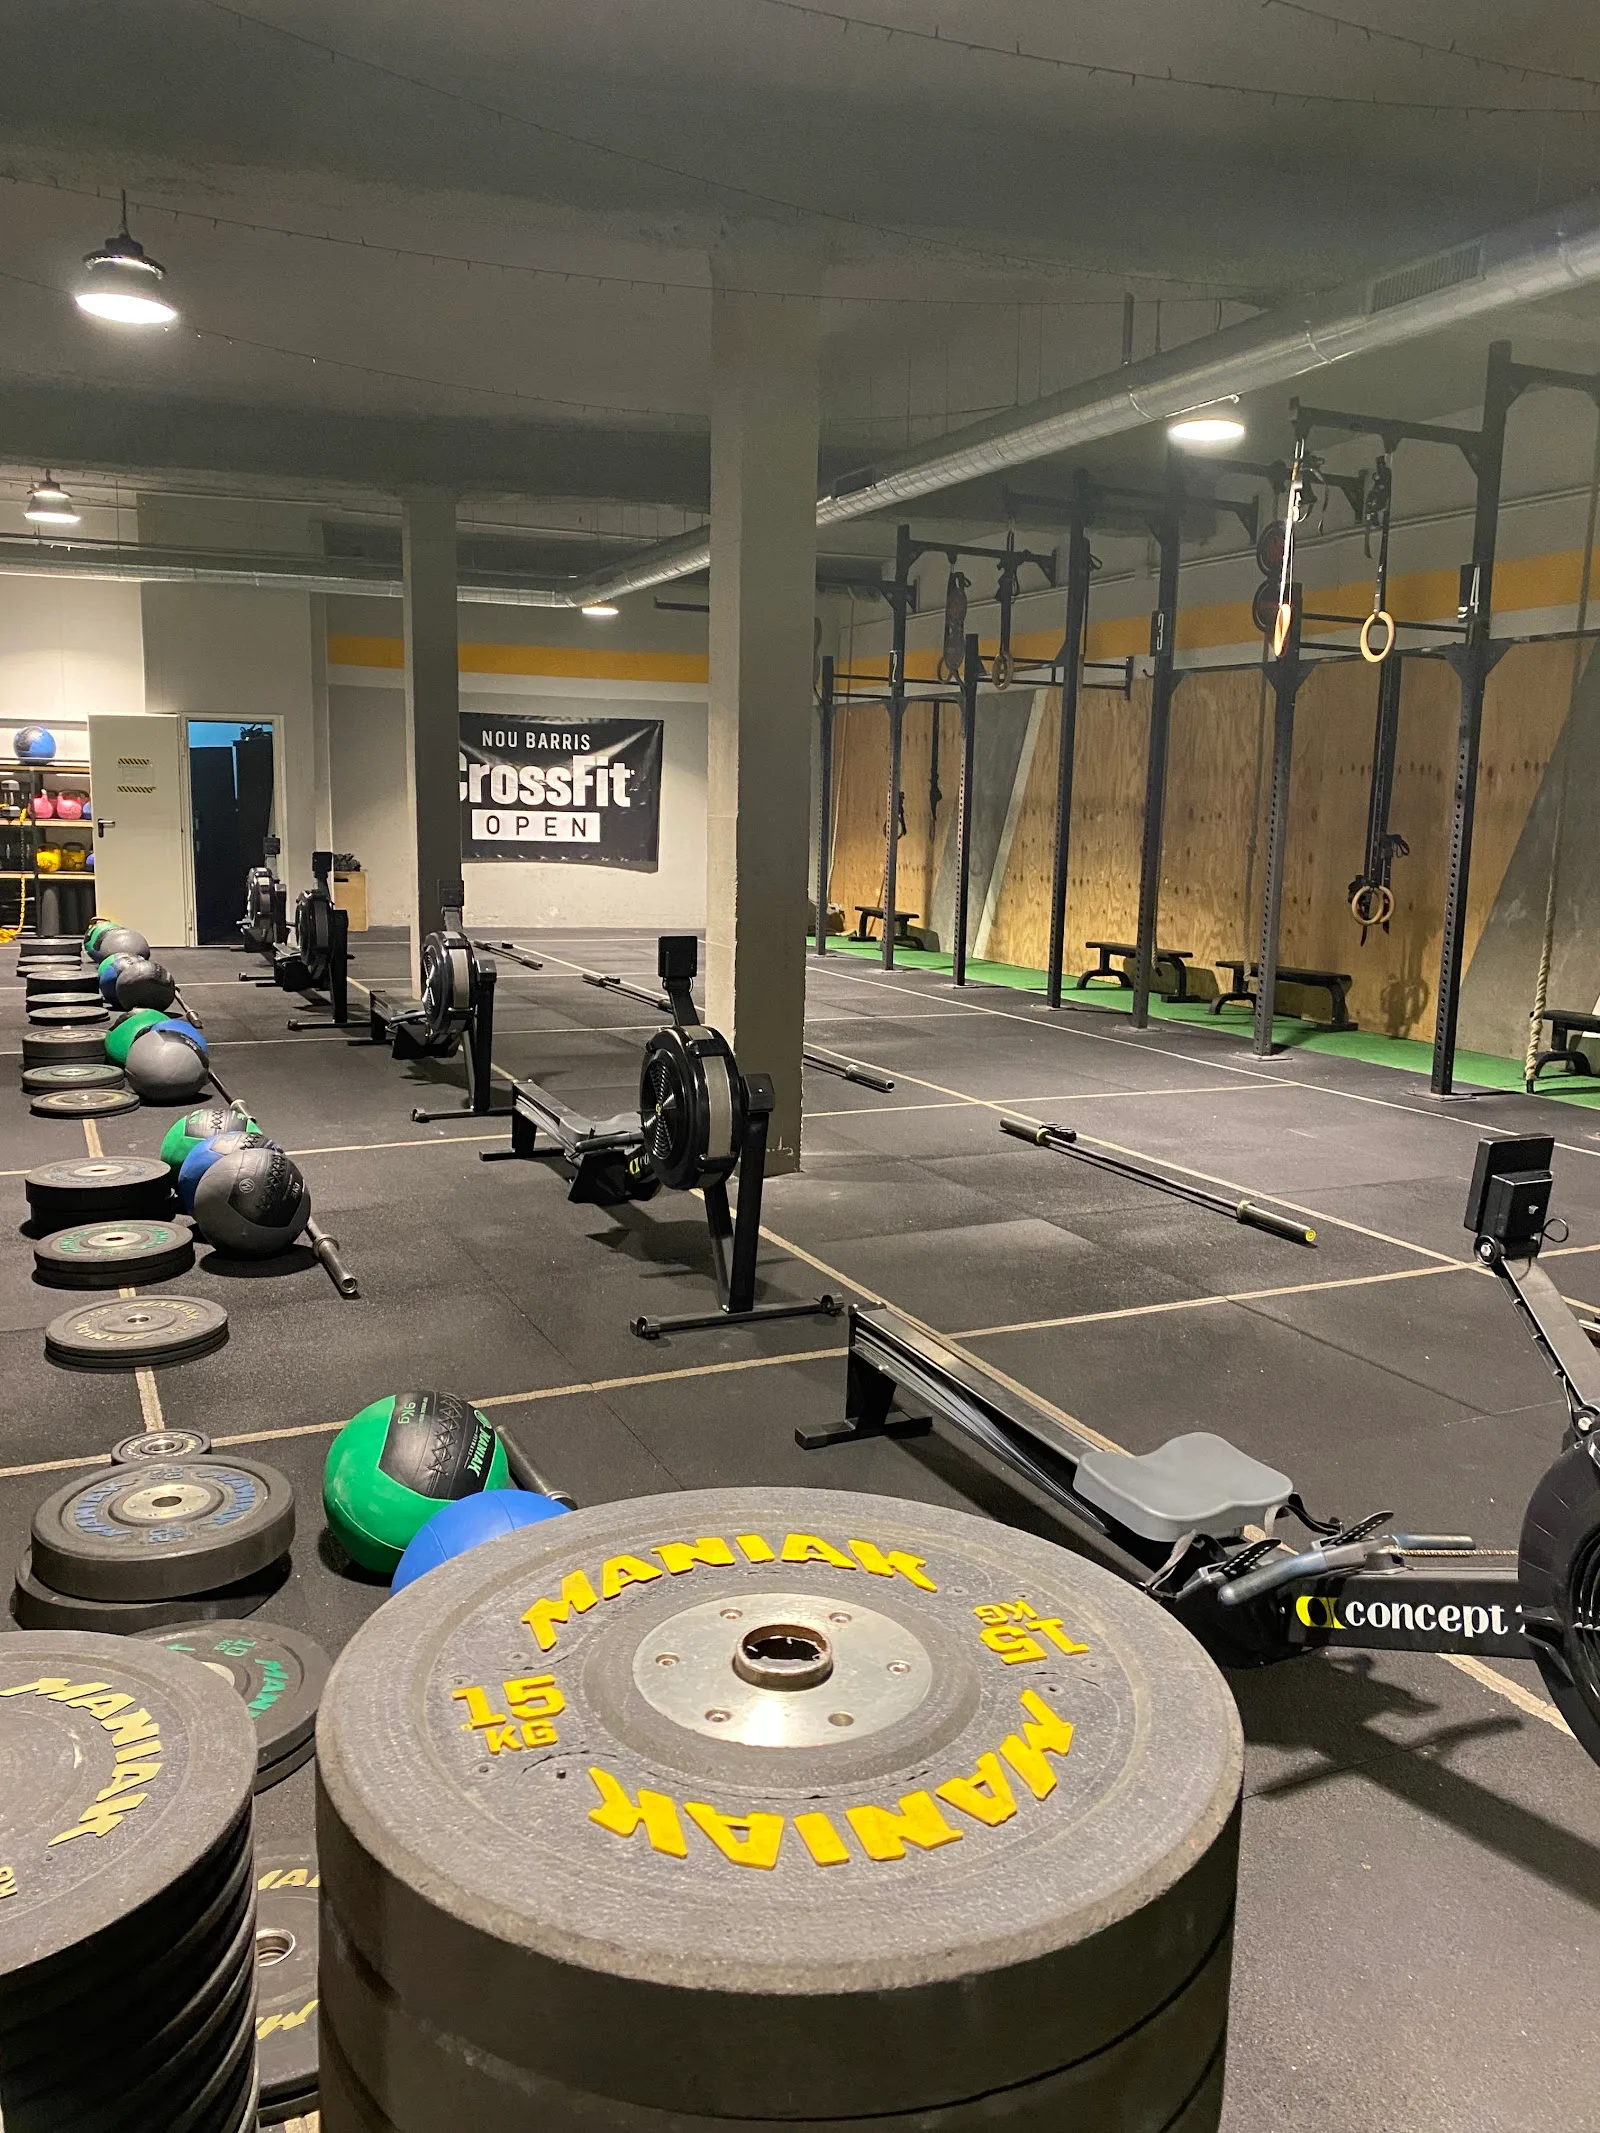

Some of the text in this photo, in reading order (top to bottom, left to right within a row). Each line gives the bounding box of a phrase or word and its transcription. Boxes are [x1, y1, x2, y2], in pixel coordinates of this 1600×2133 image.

[1469, 566, 1480, 614] 4
[1156, 612, 1165, 651] 3
[482, 730, 591, 750] NOU BARRIS
[486, 815, 587, 838] OPEN
[397, 1401, 416, 1425] 9Kg
[467, 1425, 492, 1478] MANIAK
[73, 1479, 138, 1538] MANIAK
[521, 1532, 938, 1650] MANIAK
[973, 1600, 1037, 1625] KG
[979, 1616, 1090, 1665] 15
[1345, 1600, 1509, 1638] concept
[224, 1640, 257, 1656] 10
[452, 1673, 566, 1730] 15
[485, 1723, 559, 1755] KG
[0, 1677, 163, 1847] MANIAK
[588, 1689, 1074, 1871] MANIAK
